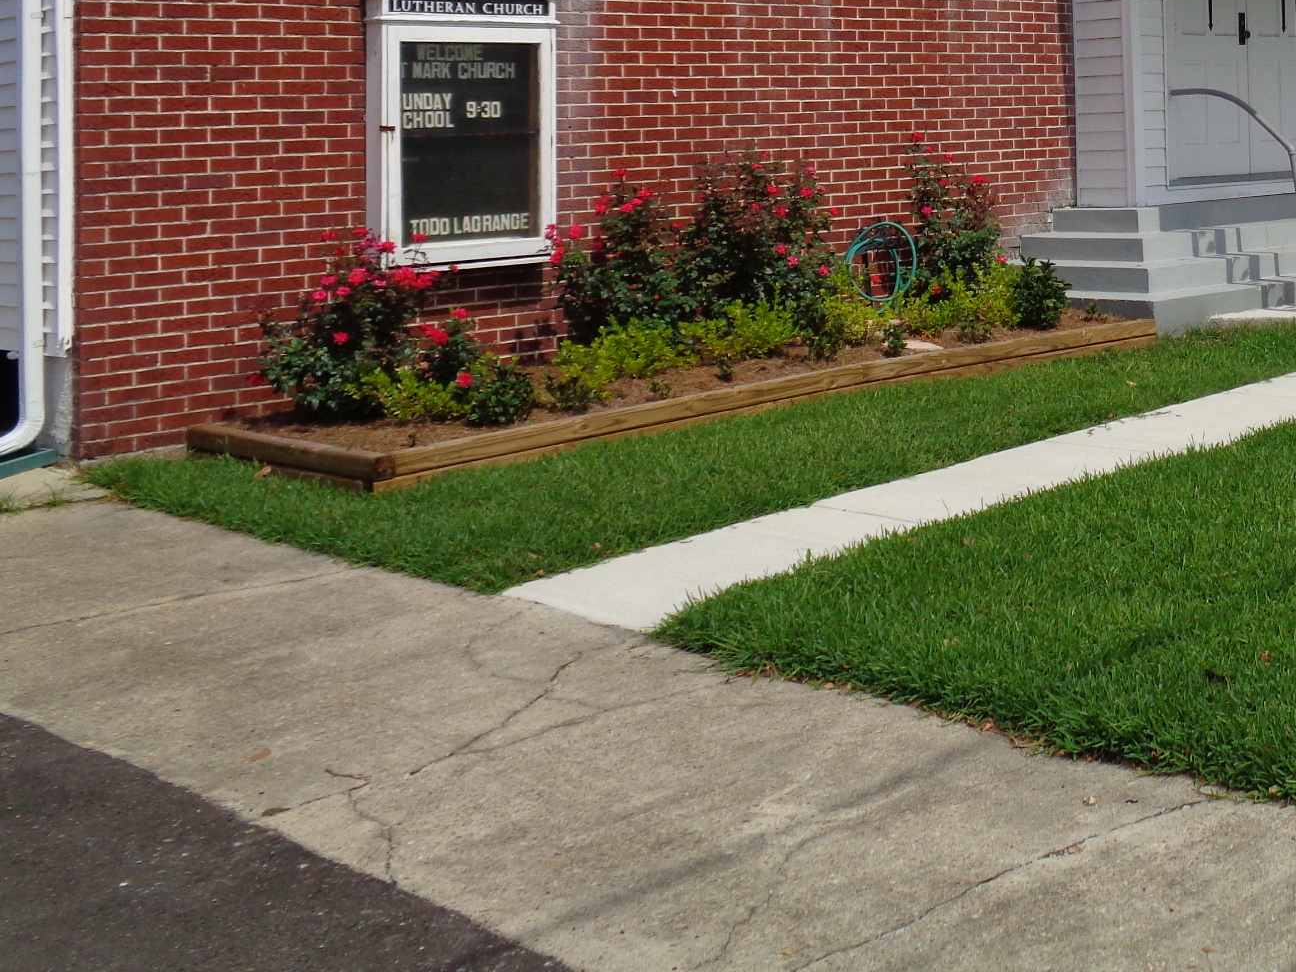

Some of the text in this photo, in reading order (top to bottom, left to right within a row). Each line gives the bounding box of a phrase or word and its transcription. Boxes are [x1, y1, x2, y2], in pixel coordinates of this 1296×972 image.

[392, 0, 543, 15] LUTHERAN CHURCH
[416, 44, 484, 61] WELCOME
[400, 62, 516, 79] T MARK CHURCH
[402, 93, 453, 111] UNDAY
[466, 101, 502, 118] 9:30
[402, 111, 454, 129] CHOOL
[410, 212, 530, 236] TODD LAGRANGE
